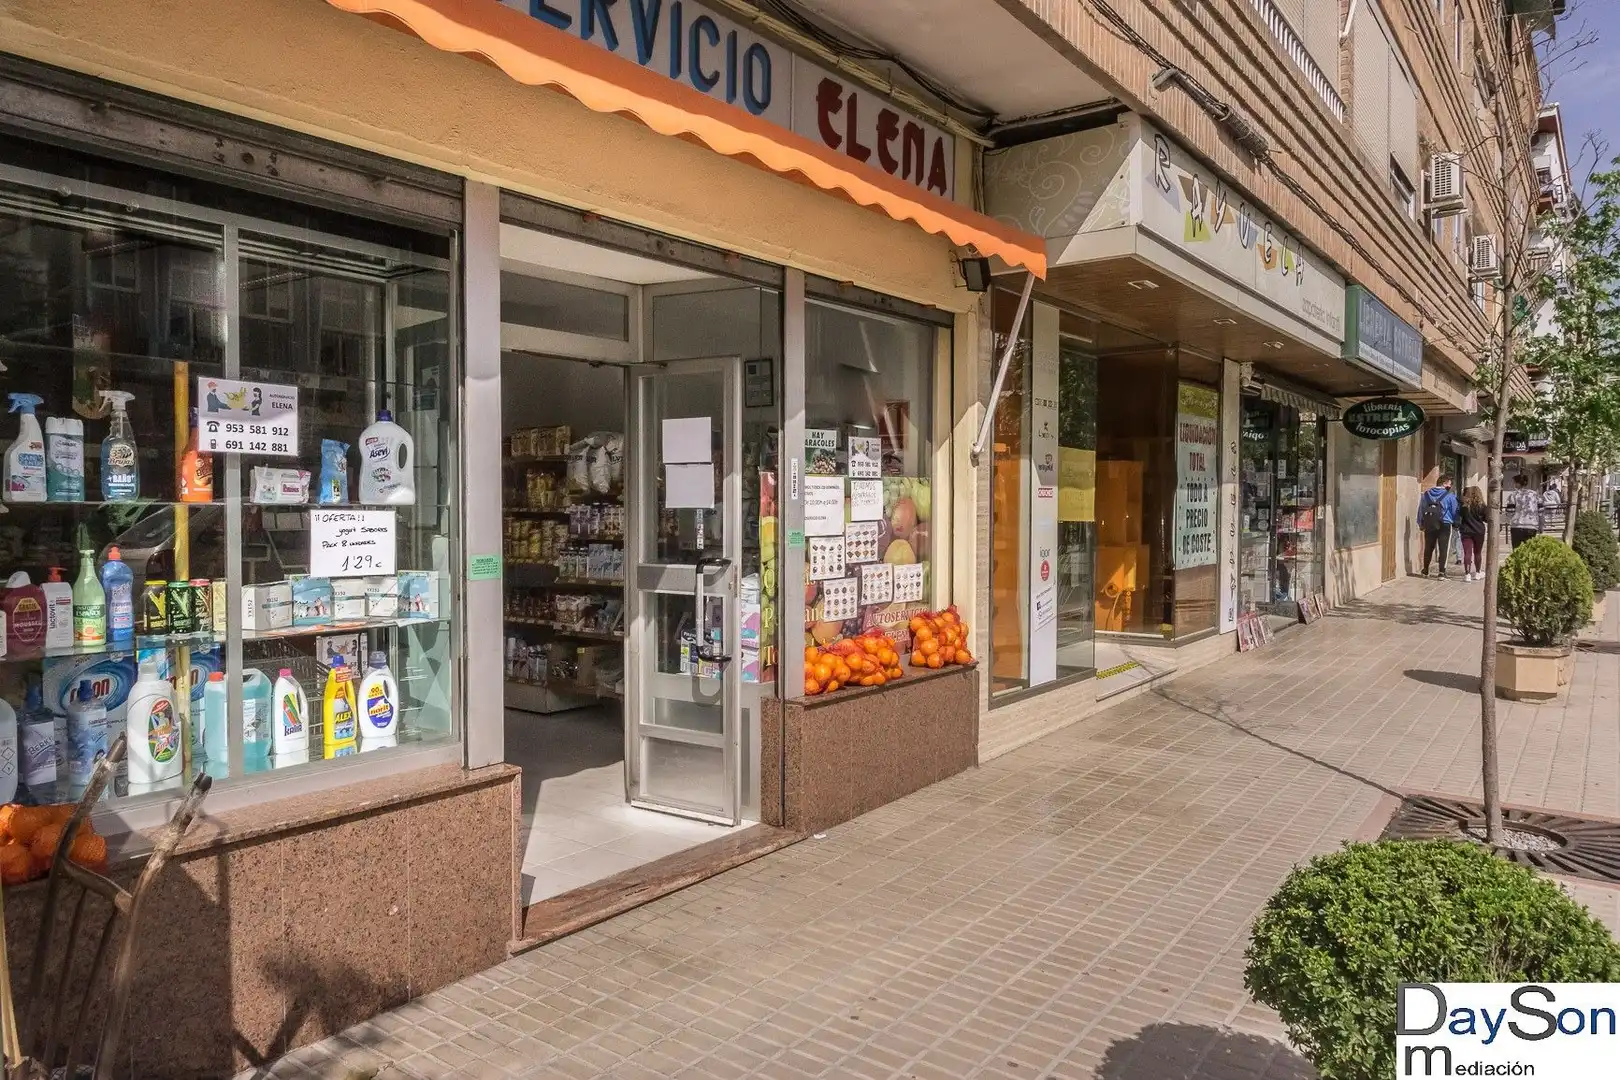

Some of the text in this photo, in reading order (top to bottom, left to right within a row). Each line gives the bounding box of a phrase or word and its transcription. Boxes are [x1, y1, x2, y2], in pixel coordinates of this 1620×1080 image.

[816, 77, 947, 197] ELENA
[1154, 133, 1304, 287] RAYUELA
[271, 401, 293, 410] ELENA
[226, 424, 288, 436] 953 581 912
[226, 440, 288, 452] 691 142 881
[804, 439, 834, 447] ARACOLES
[1190, 452, 1206, 472] TOTAL
[1186, 483, 1202, 502] TODO
[1186, 508, 1208, 528] PRECIO
[1182, 533, 1212, 555] DE COSTE
[336, 711, 352, 723] ALEX
[370, 704, 390, 716] norit
